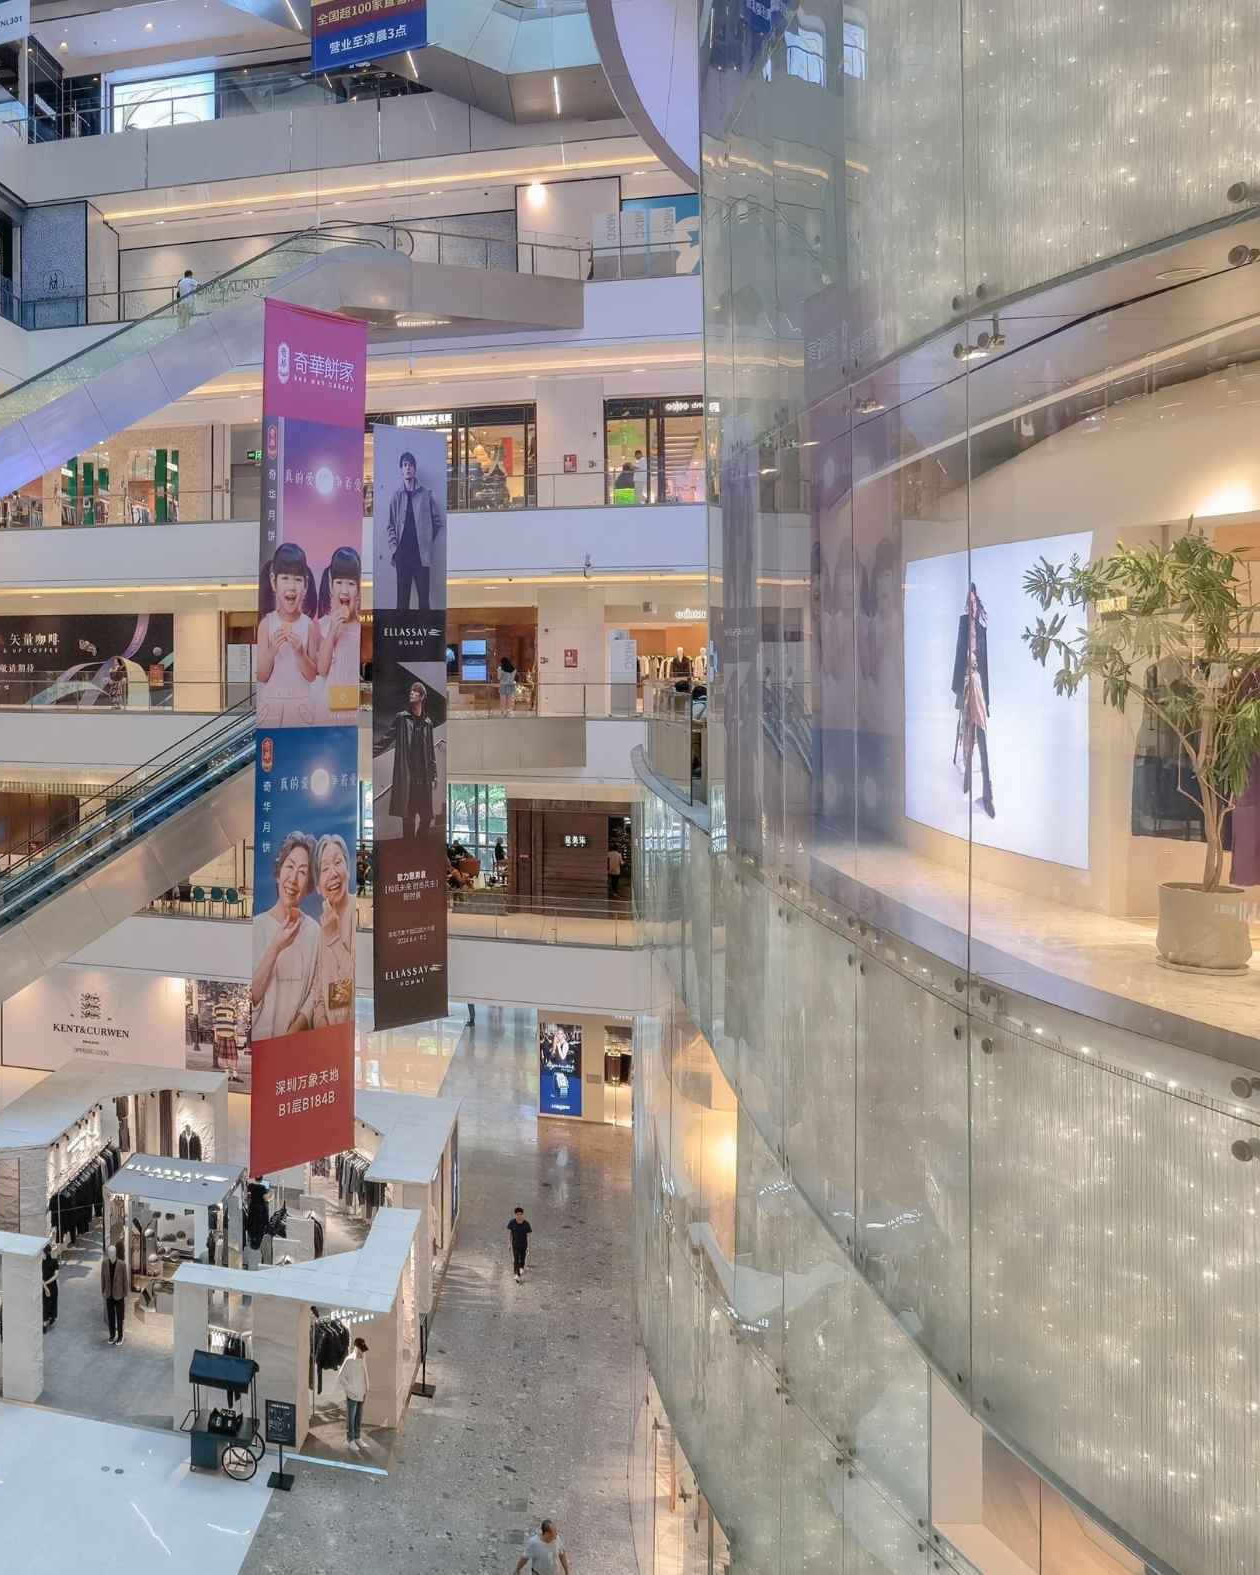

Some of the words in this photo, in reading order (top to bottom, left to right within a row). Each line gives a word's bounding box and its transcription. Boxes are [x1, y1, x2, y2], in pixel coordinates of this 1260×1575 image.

[329, 24, 407, 54] 营业至凌晨3点
[293, 351, 355, 383] 奇華餅家
[9, 632, 60, 647] 矢量咖啡
[383, 627, 428, 637] ELLASSAY
[385, 964, 430, 981] ELLASSAY
[275, 1066, 340, 1096] 深圳万象天地
[278, 1090, 335, 1117] B1层B184B
